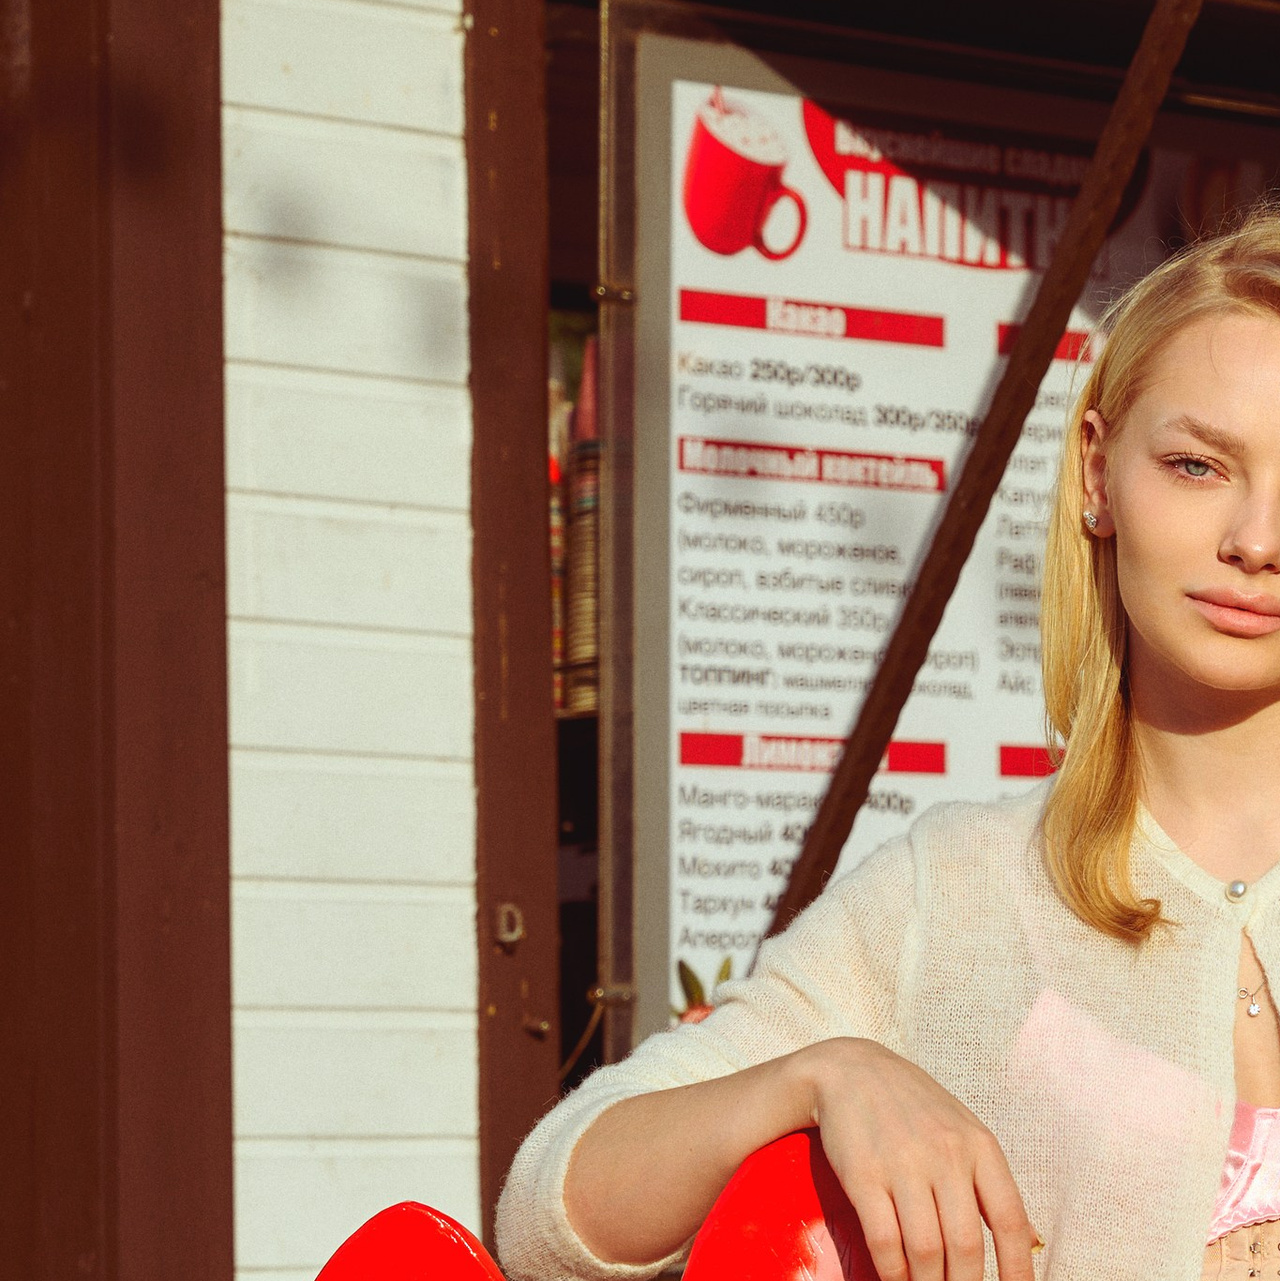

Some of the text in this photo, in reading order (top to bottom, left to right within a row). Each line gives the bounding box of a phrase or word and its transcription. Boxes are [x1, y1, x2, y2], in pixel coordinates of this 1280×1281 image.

[842, 167, 1080, 272] НАПИТК
[678, 349, 862, 392] Какао 250р/300р
[679, 384, 768, 415] Горячий
[774, 396, 867, 427] шоколад
[678, 490, 866, 529] Фирменный 450р
[755, 568, 844, 592] взбитые
[679, 595, 894, 633] Классический 350р
[679, 819, 773, 845] Ягодный
[679, 856, 764, 880] Мохито
[679, 889, 756, 915] Тархун
